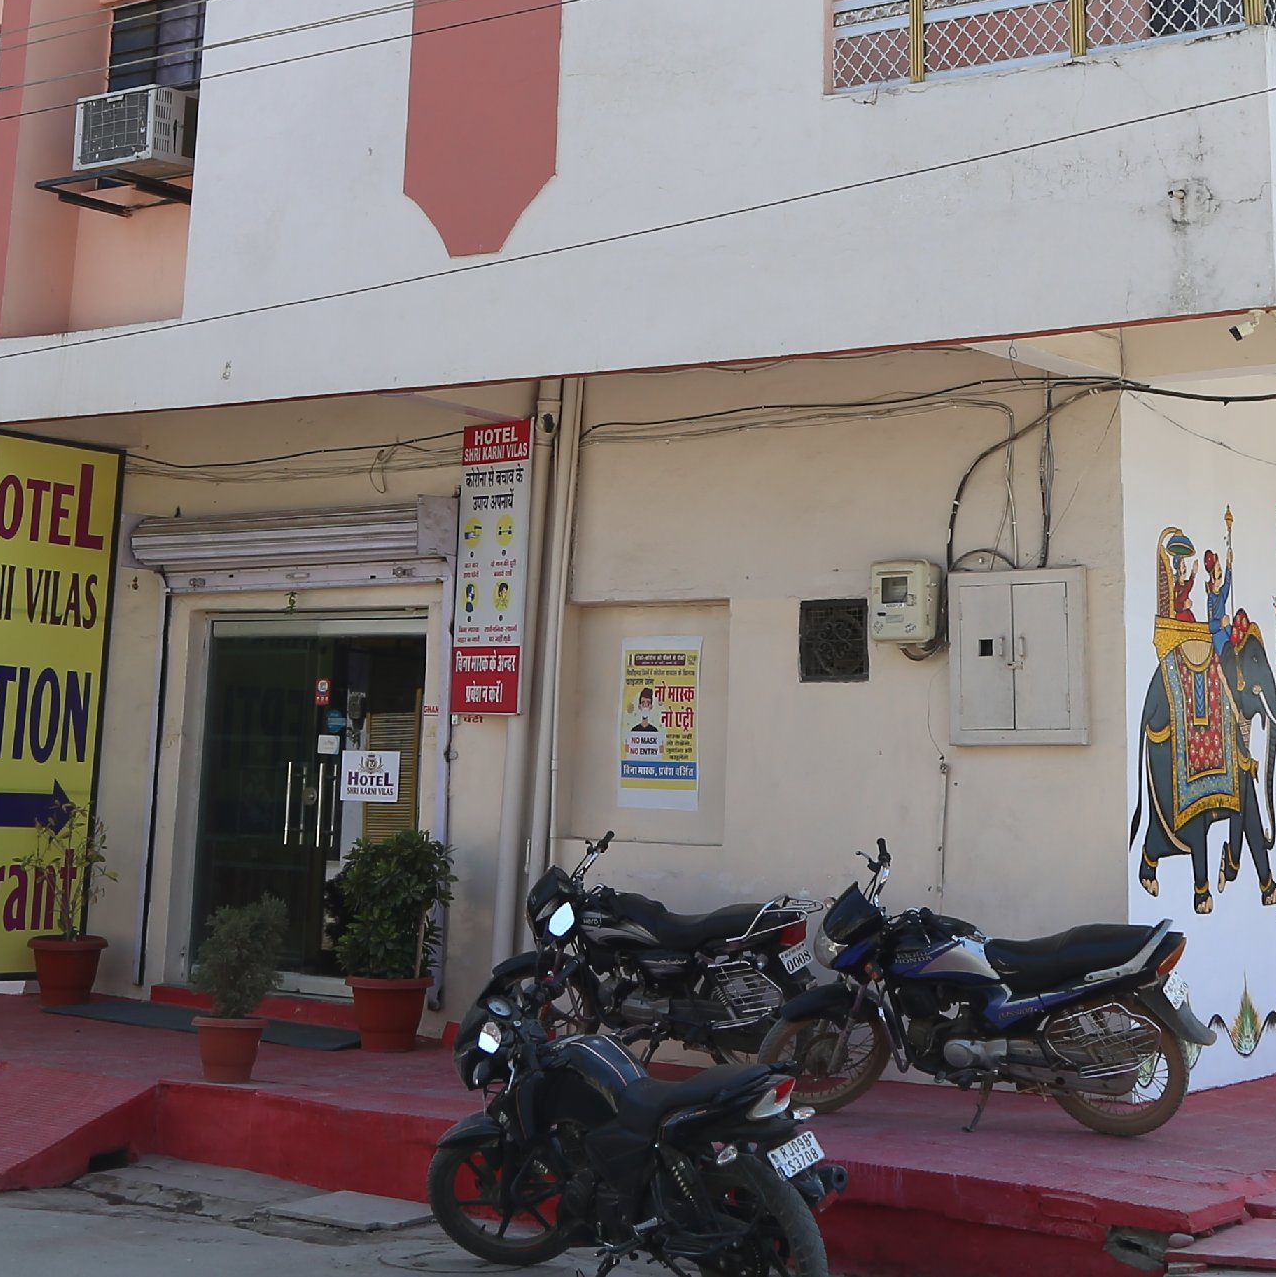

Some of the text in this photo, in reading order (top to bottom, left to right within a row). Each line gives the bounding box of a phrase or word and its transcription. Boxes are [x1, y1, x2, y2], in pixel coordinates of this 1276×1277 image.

[474, 426, 518, 445] HOTEL
[464, 442, 528, 462] SHRI KARNI VILAS
[465, 467, 487, 487] कोरोना
[26, 567, 98, 629] VILAS
[455, 650, 470, 672] बिना
[654, 681, 695, 702] नो मास्क
[661, 706, 673, 728] नो
[639, 747, 659, 755] ENTRY
[348, 771, 394, 787] HOTEL
[623, 764, 637, 775] बिना
[346, 787, 394, 796] SHRI KARNI VILAS
[786, 949, 812, 972] 0008
